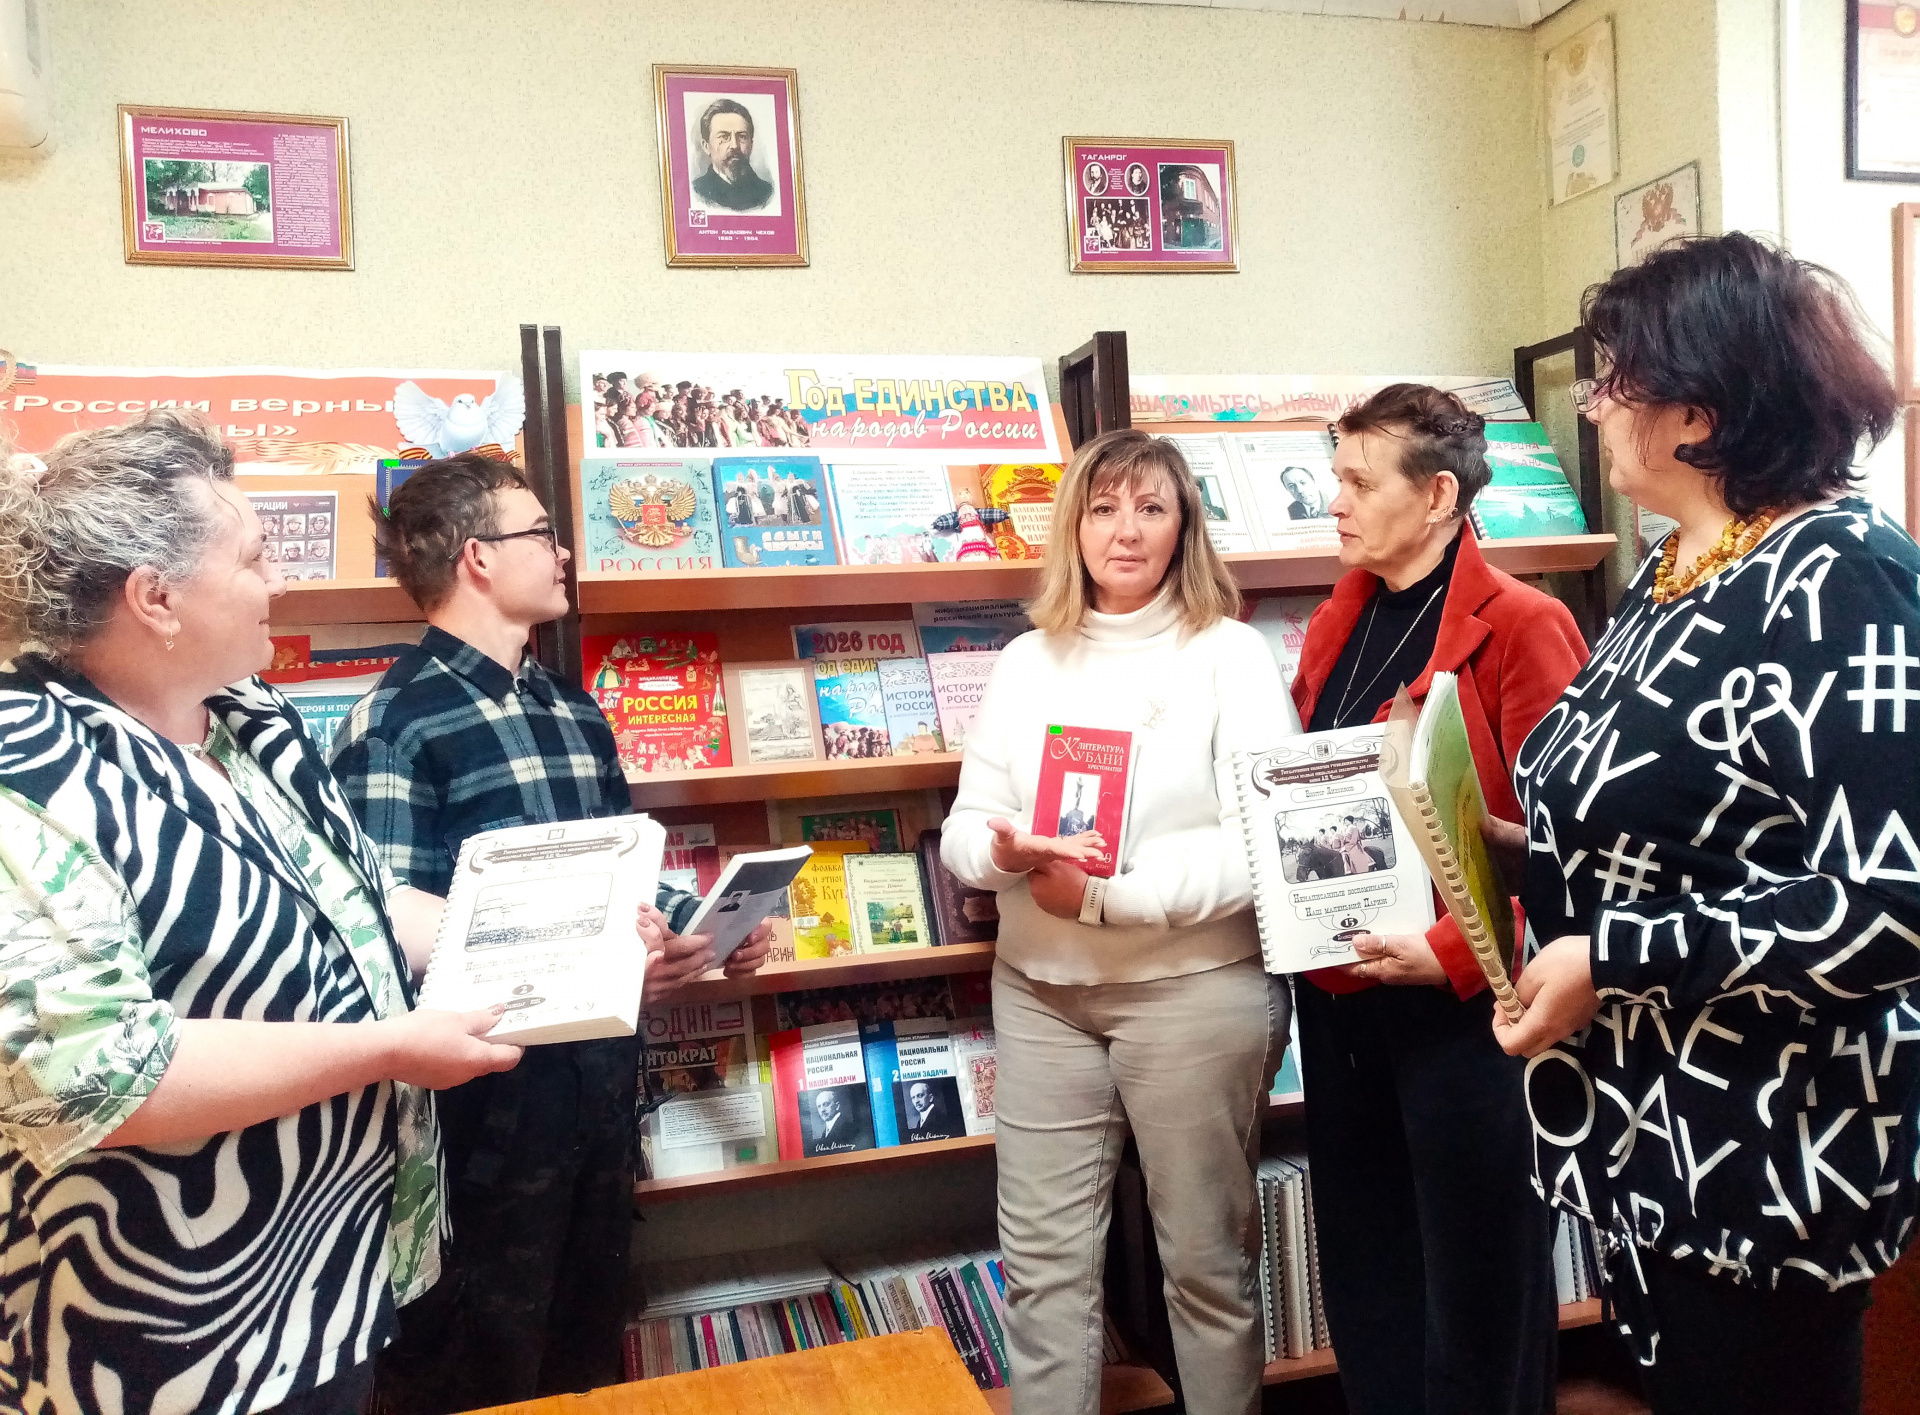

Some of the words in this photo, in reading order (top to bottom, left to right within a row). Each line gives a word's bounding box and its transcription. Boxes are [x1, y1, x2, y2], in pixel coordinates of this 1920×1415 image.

[141, 126, 207, 137] МЕЛИХОВО
[853, 379, 1033, 417] ЕДИНСТВА
[231, 398, 395, 417] верны
[811, 410, 927, 446] народов
[939, 408, 1037, 440] России
[252, 502, 288, 510] ЕРАЦИИ
[811, 631, 863, 653] 2026
[886, 690, 935, 702] ИСТОРИ
[947, 694, 983, 704] РОССИ
[623, 695, 698, 713] РОССИЯ
[896, 702, 934, 712] РОССИ
[628, 714, 696, 725] ИНТЕРЕСНАЯ
[1076, 742, 1124, 754] ЛИТЕРАТУРА
[1345, 919, 1355, 928] 15
[519, 985, 527, 993] 2
[899, 1045, 949, 1057] НАЦИОНАЛЬНАЯ
[806, 1050, 858, 1064] НАЦИОНАЛЬНАЯ
[901, 1058, 926, 1067] РОССИЯ
[807, 1065, 833, 1075] РОССИЯ
[902, 1071, 922, 1080] НАШИ
[923, 1069, 948, 1078] ЗАДАЧИ
[808, 1077, 829, 1088] НАШИ
[829, 1075, 857, 1085] ЗАДАЧИ
